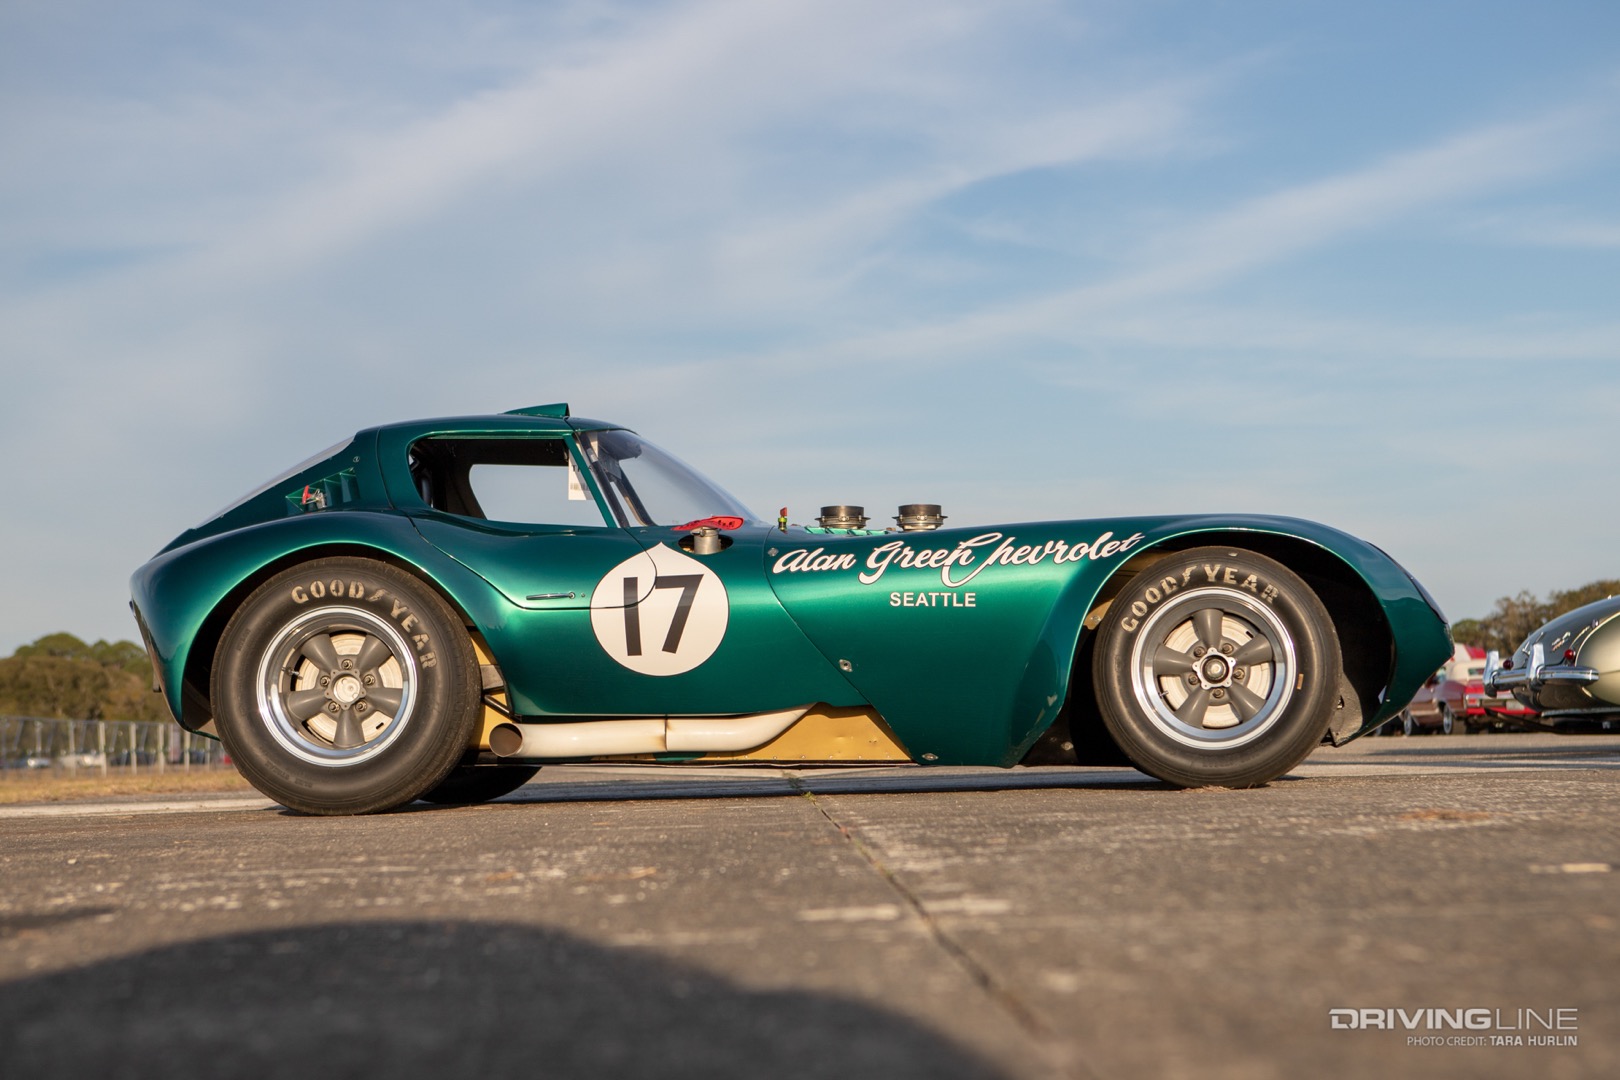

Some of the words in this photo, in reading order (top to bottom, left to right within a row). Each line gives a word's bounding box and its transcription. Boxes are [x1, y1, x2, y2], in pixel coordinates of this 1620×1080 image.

[772, 548, 857, 574] Alan
[858, 540, 976, 585] Green
[941, 531, 1146, 588] Chevrolet
[623, 573, 704, 657] 17
[890, 592, 976, 608] SEATTLE
